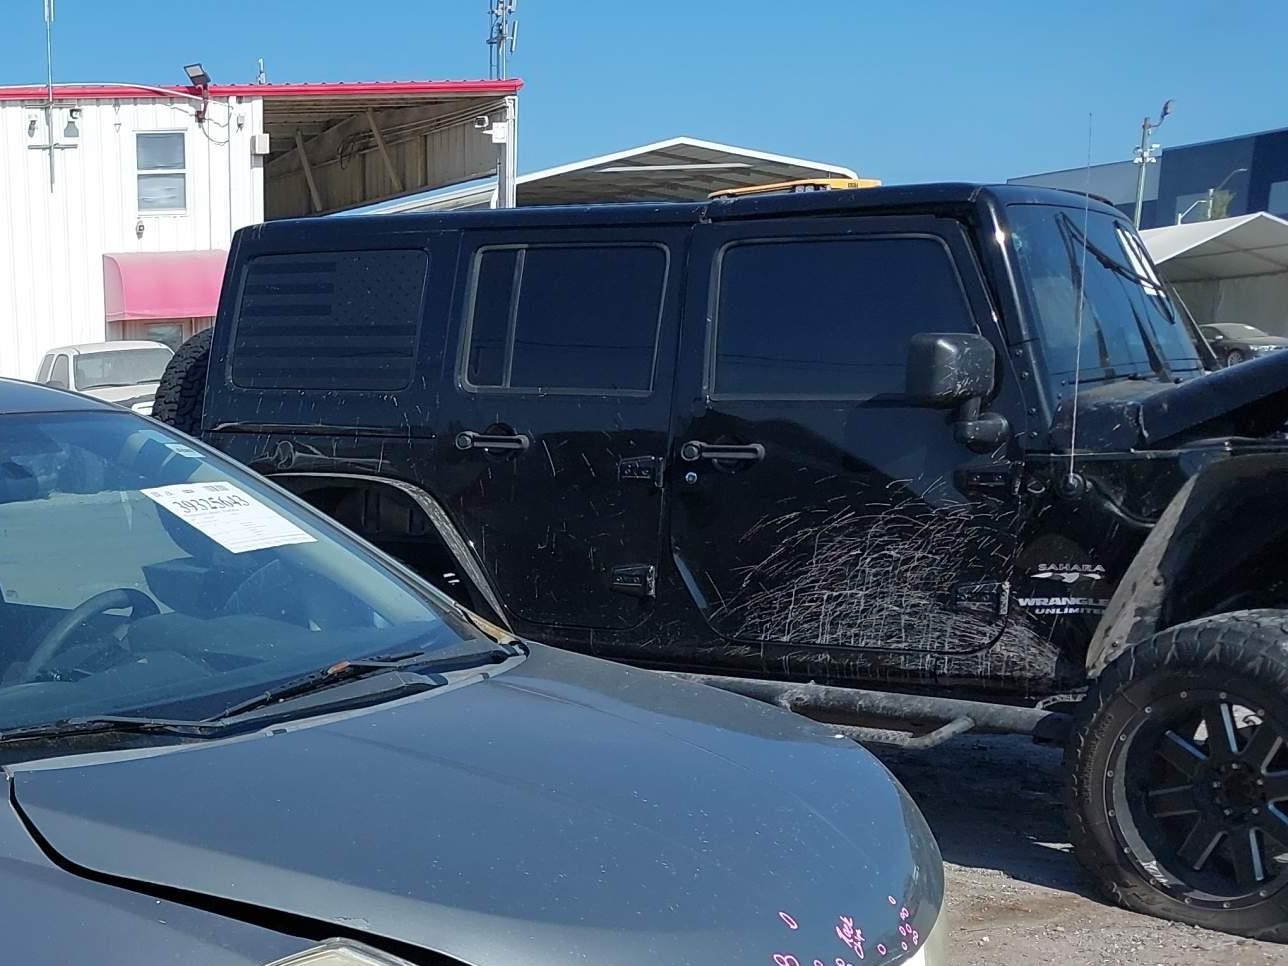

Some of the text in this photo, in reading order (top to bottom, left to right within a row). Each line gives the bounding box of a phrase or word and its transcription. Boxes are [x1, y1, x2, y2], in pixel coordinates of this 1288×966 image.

[172, 495, 250, 513] 39325643
[1038, 563, 1106, 572] SAHARA
[1018, 597, 1110, 607] WRANGLE
